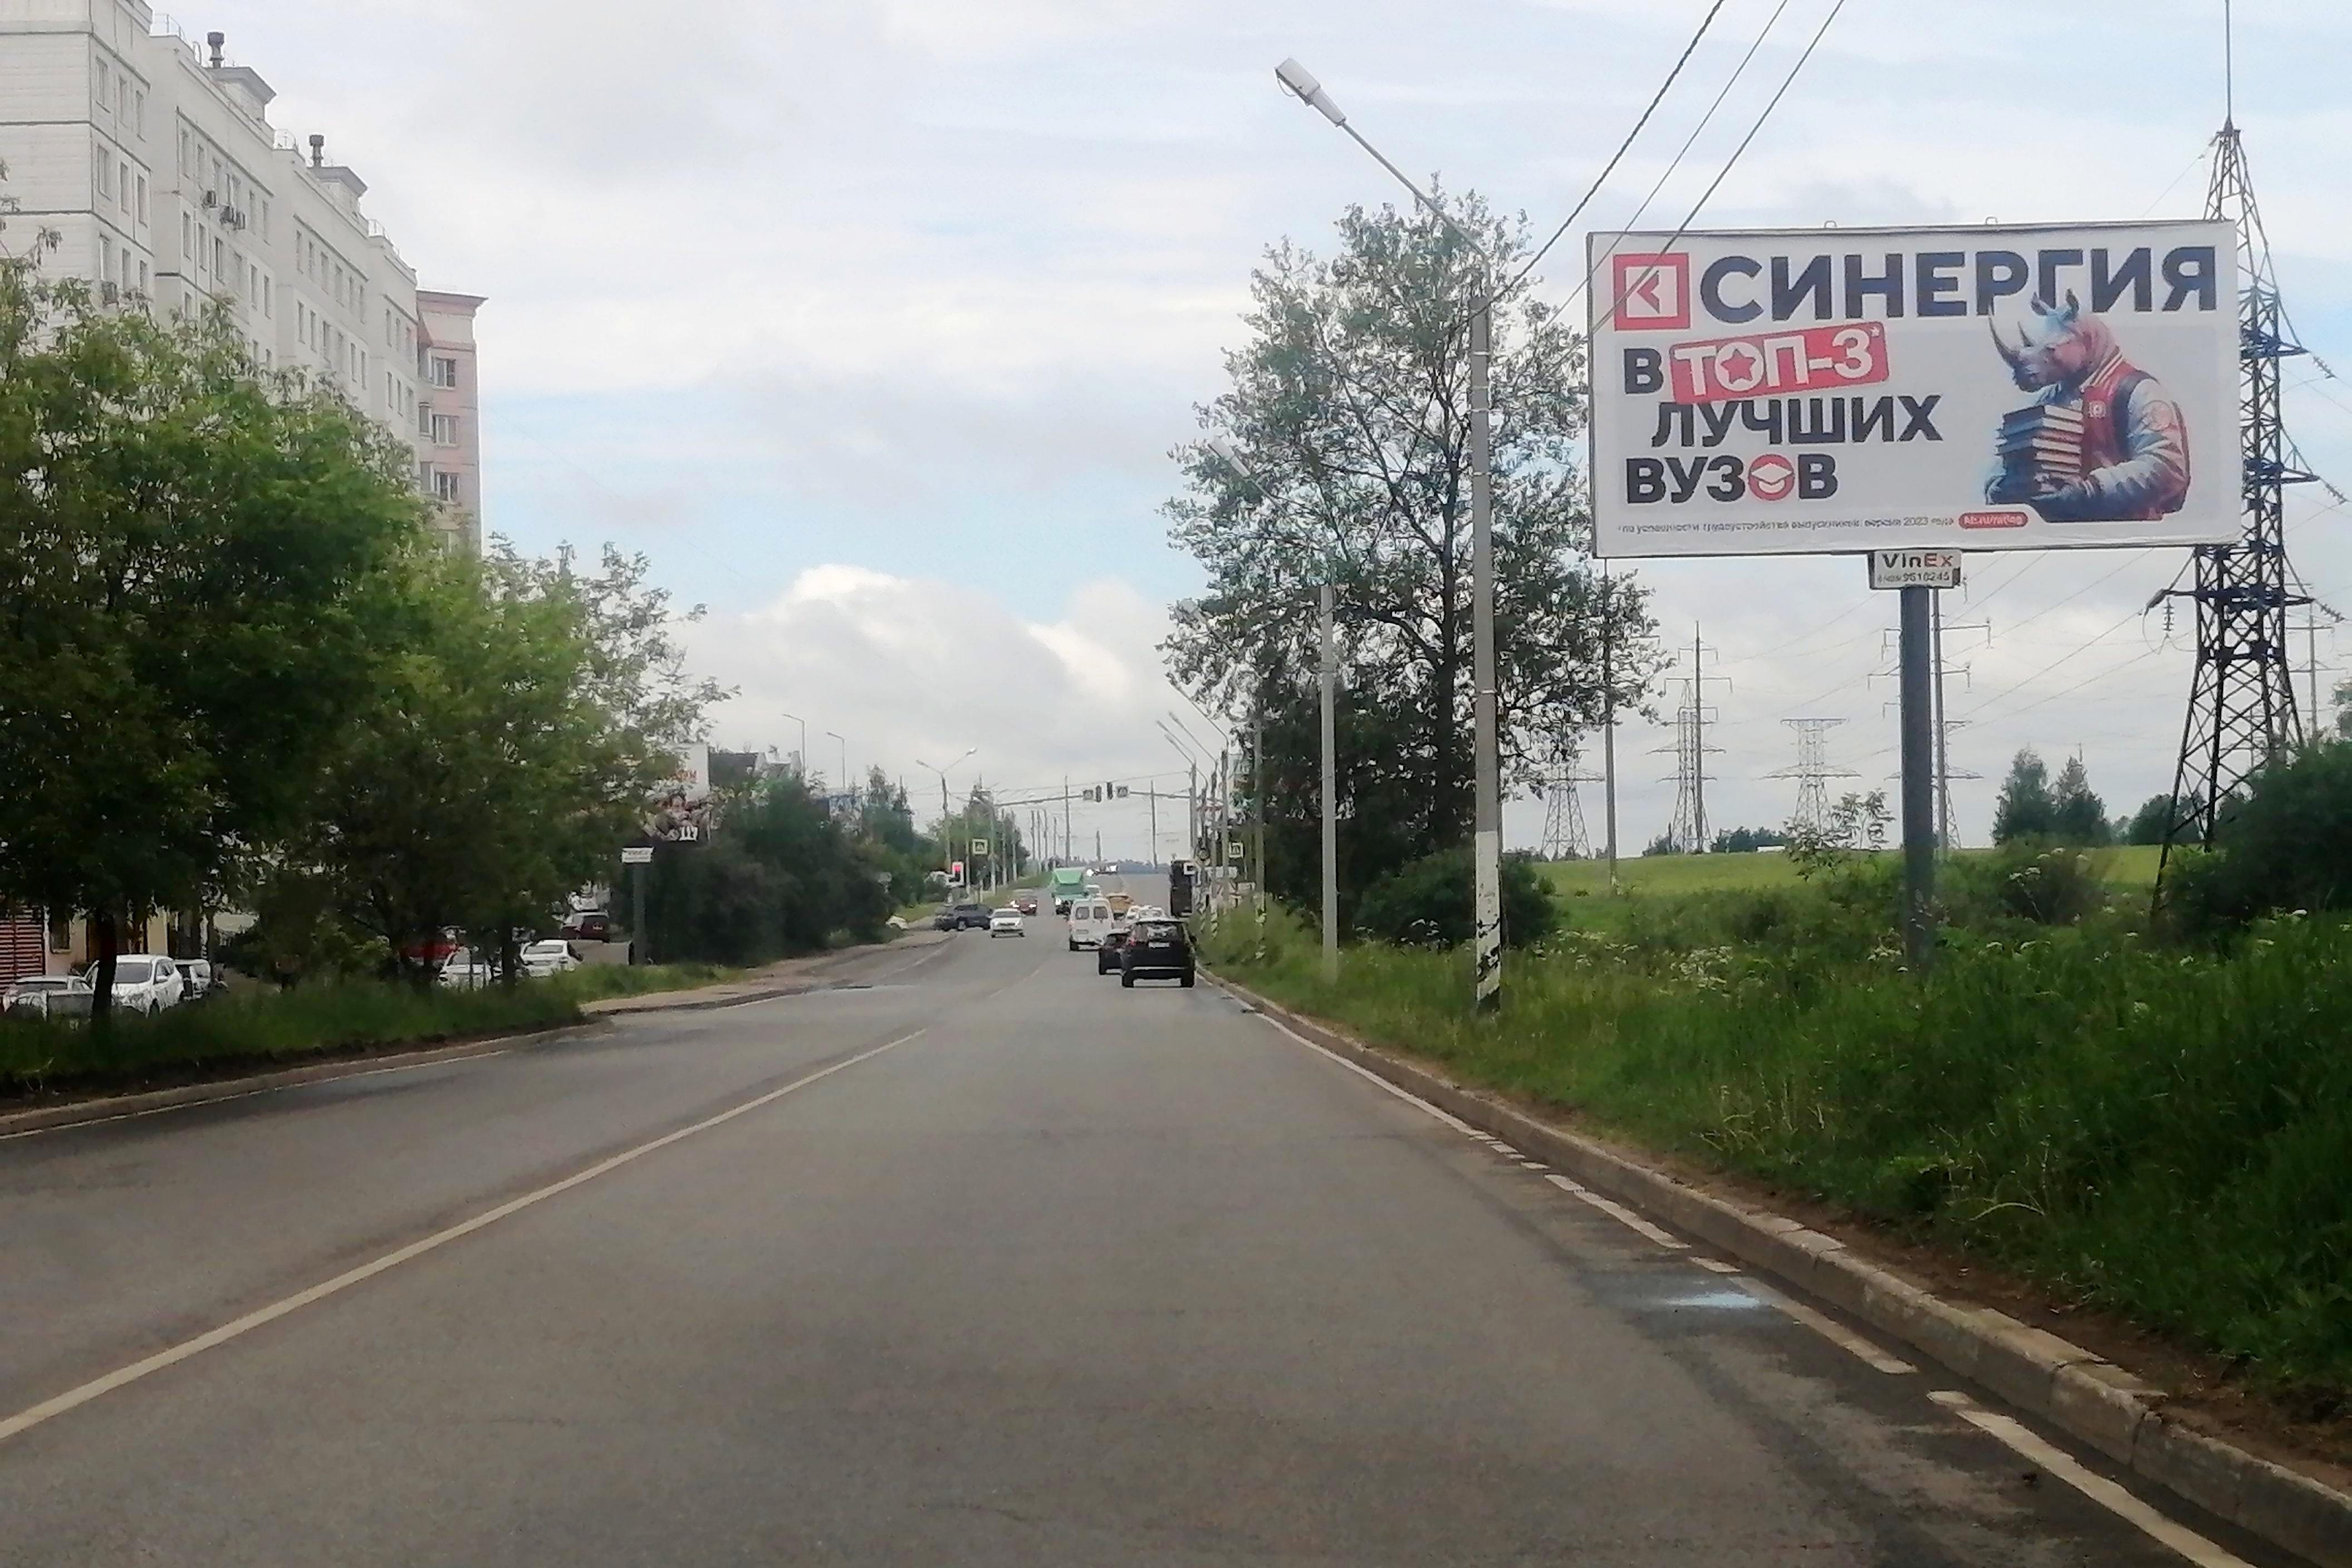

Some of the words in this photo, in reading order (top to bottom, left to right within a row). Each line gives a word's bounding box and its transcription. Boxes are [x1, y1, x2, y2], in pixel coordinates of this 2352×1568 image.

[1701, 246, 2216, 324] СИНЕРГИЯ
[1624, 348, 1664, 395] В
[1652, 395, 1943, 447] ЛУЧШИХ
[1626, 454, 1839, 503] ВУЗОВ
[1903, 516, 1929, 526] 2023
